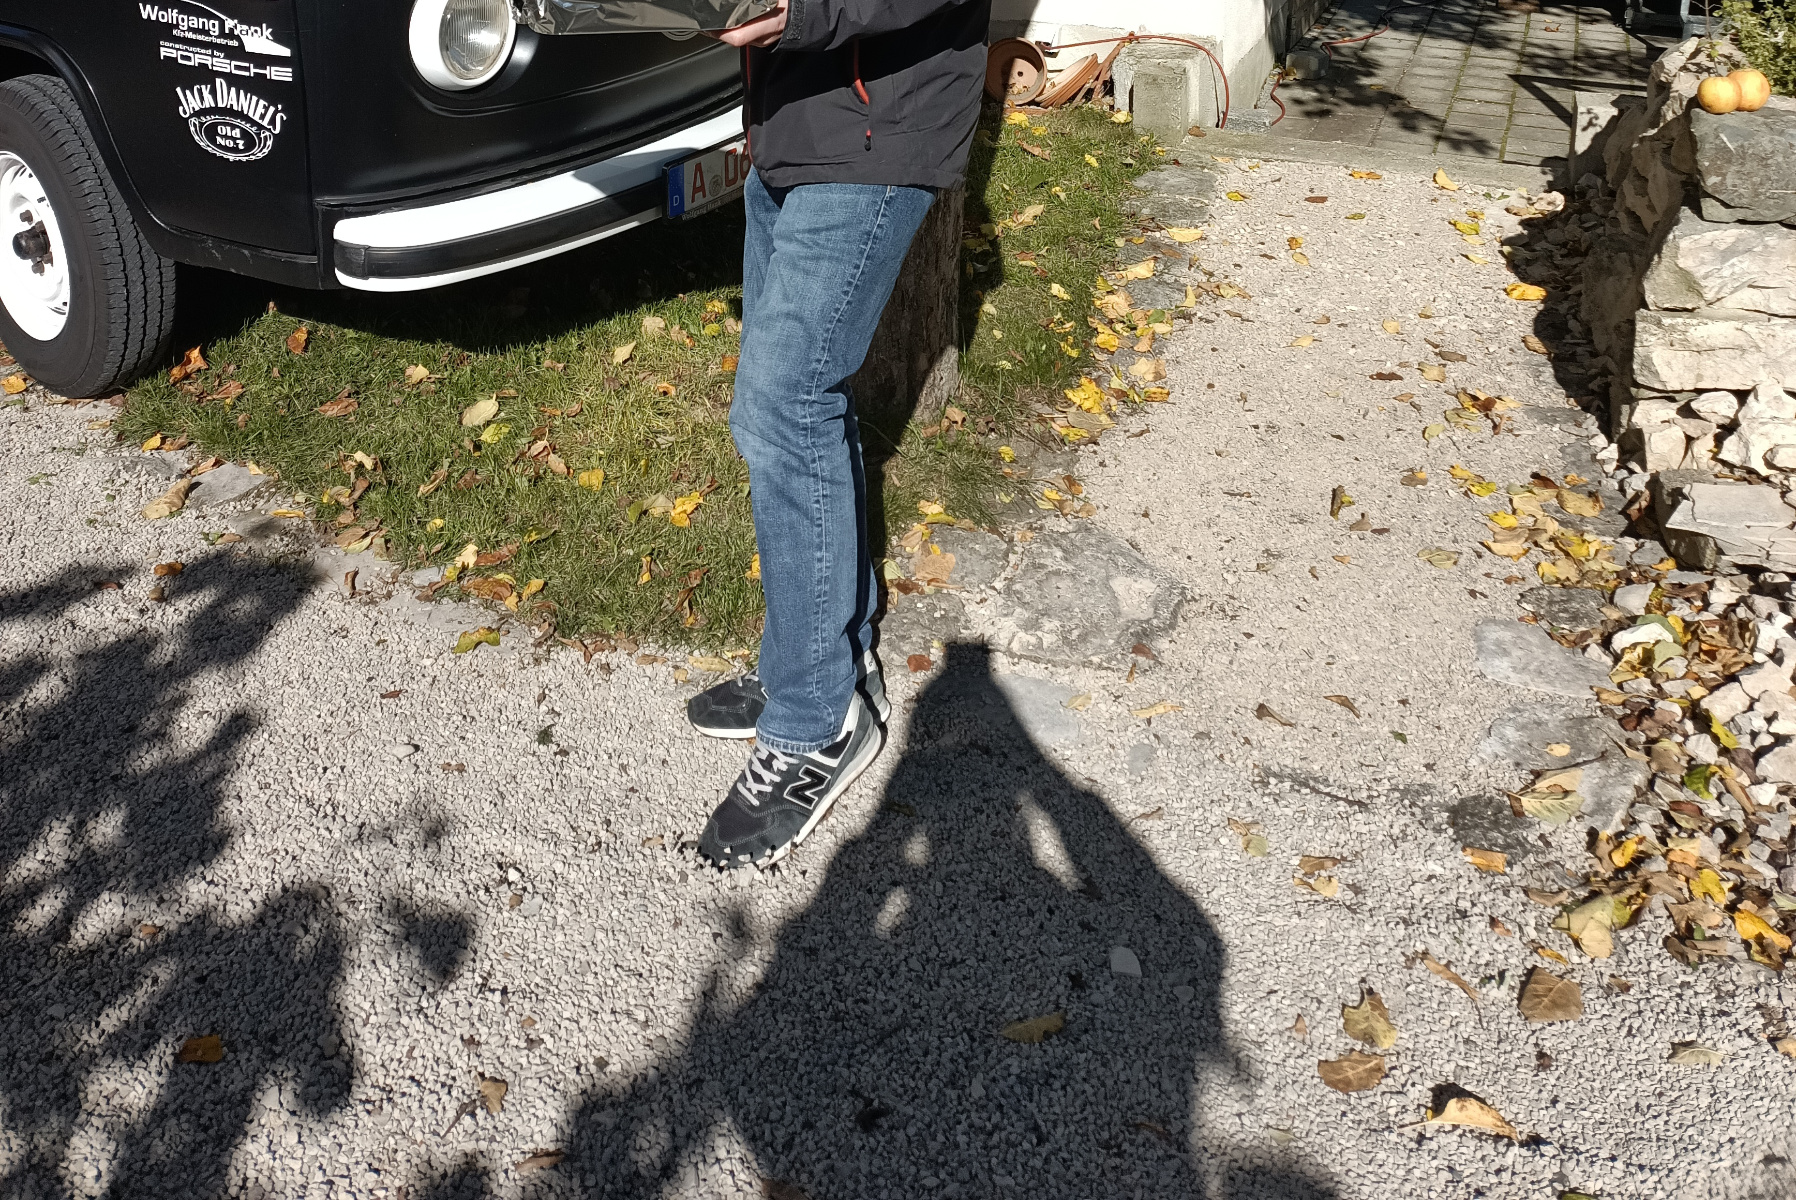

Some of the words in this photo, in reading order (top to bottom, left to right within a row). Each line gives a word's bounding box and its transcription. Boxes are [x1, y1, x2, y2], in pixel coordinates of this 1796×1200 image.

[138, 2, 220, 36] Wolfgang
[159, 40, 212, 55] constructed
[213, 49, 225, 59] by
[172, 28, 239, 47] Kfz-Meisterbetrieb
[159, 47, 293, 82] PORSCHE
[175, 84, 216, 119] JACK
[215, 77, 287, 135] DANIEL'S
[215, 135, 245, 150] No.7
[217, 125, 241, 139] Old
[673, 195, 680, 207] D
[691, 162, 706, 203] A
